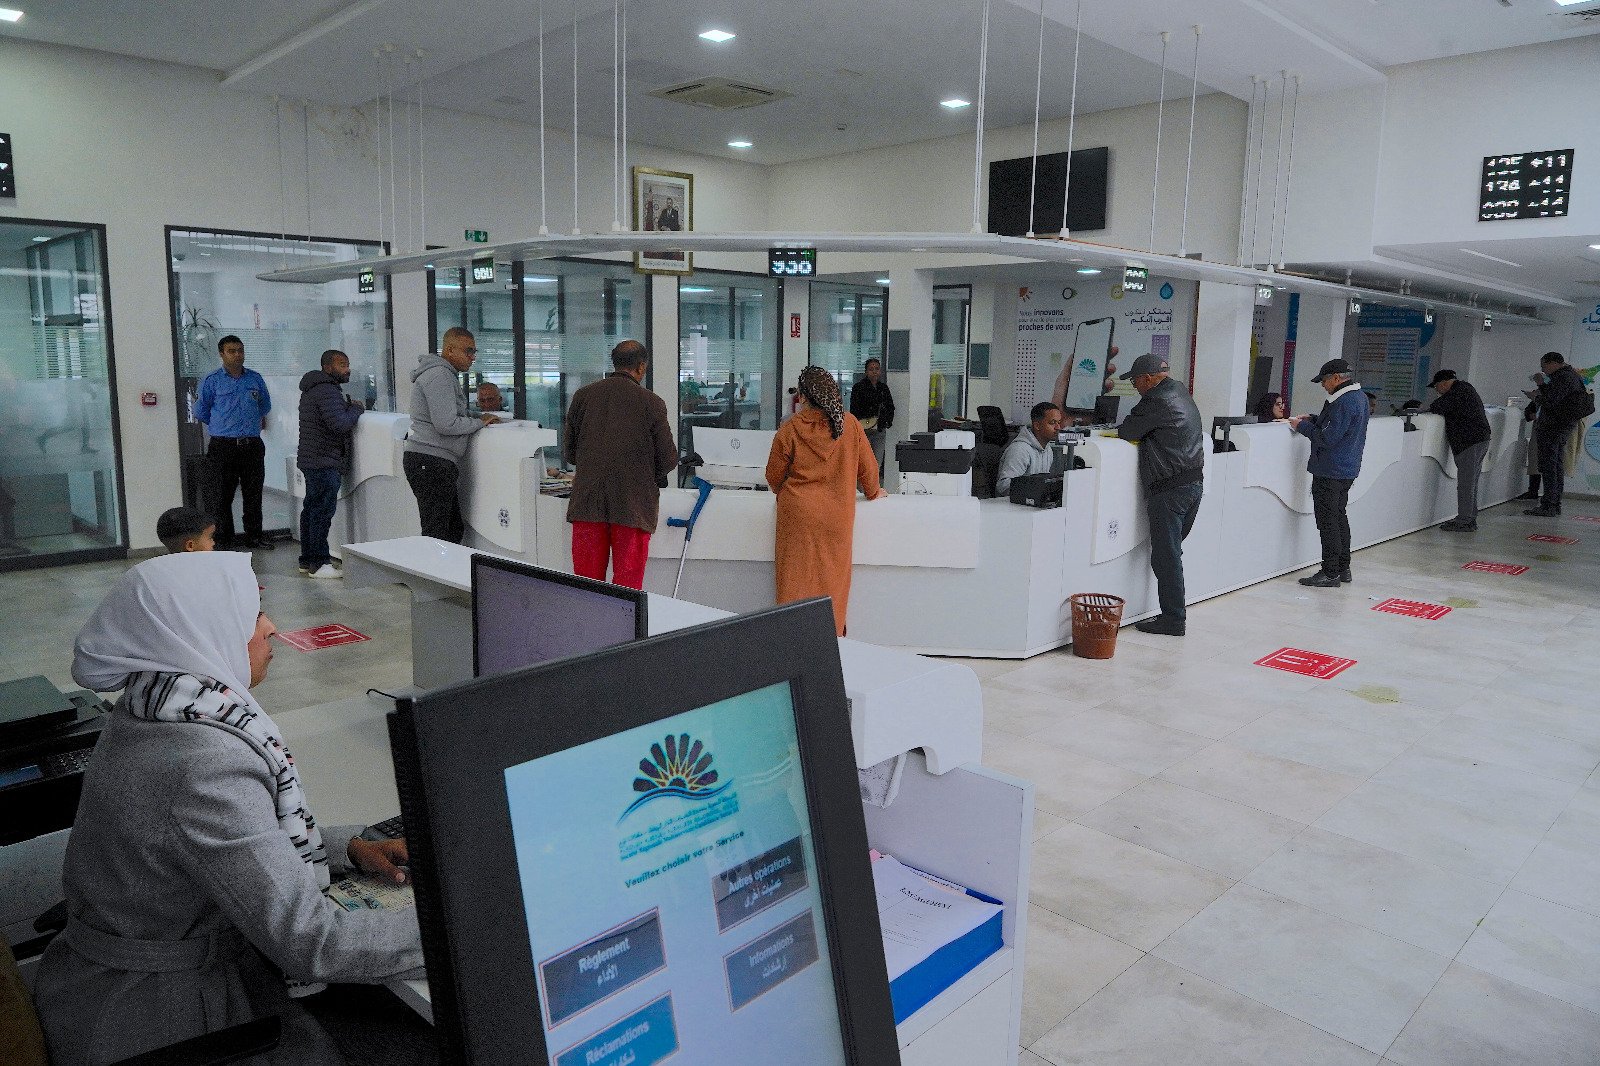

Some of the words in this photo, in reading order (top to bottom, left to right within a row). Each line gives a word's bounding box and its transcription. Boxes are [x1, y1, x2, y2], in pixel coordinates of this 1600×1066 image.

[1018, 323, 1044, 331] proches
[1045, 323, 1054, 331] de
[625, 868, 661, 888] Veuillez
[662, 852, 691, 873] choisir
[692, 844, 714, 858] votre
[715, 830, 745, 847] Service
[749, 934, 794, 967] Informations
